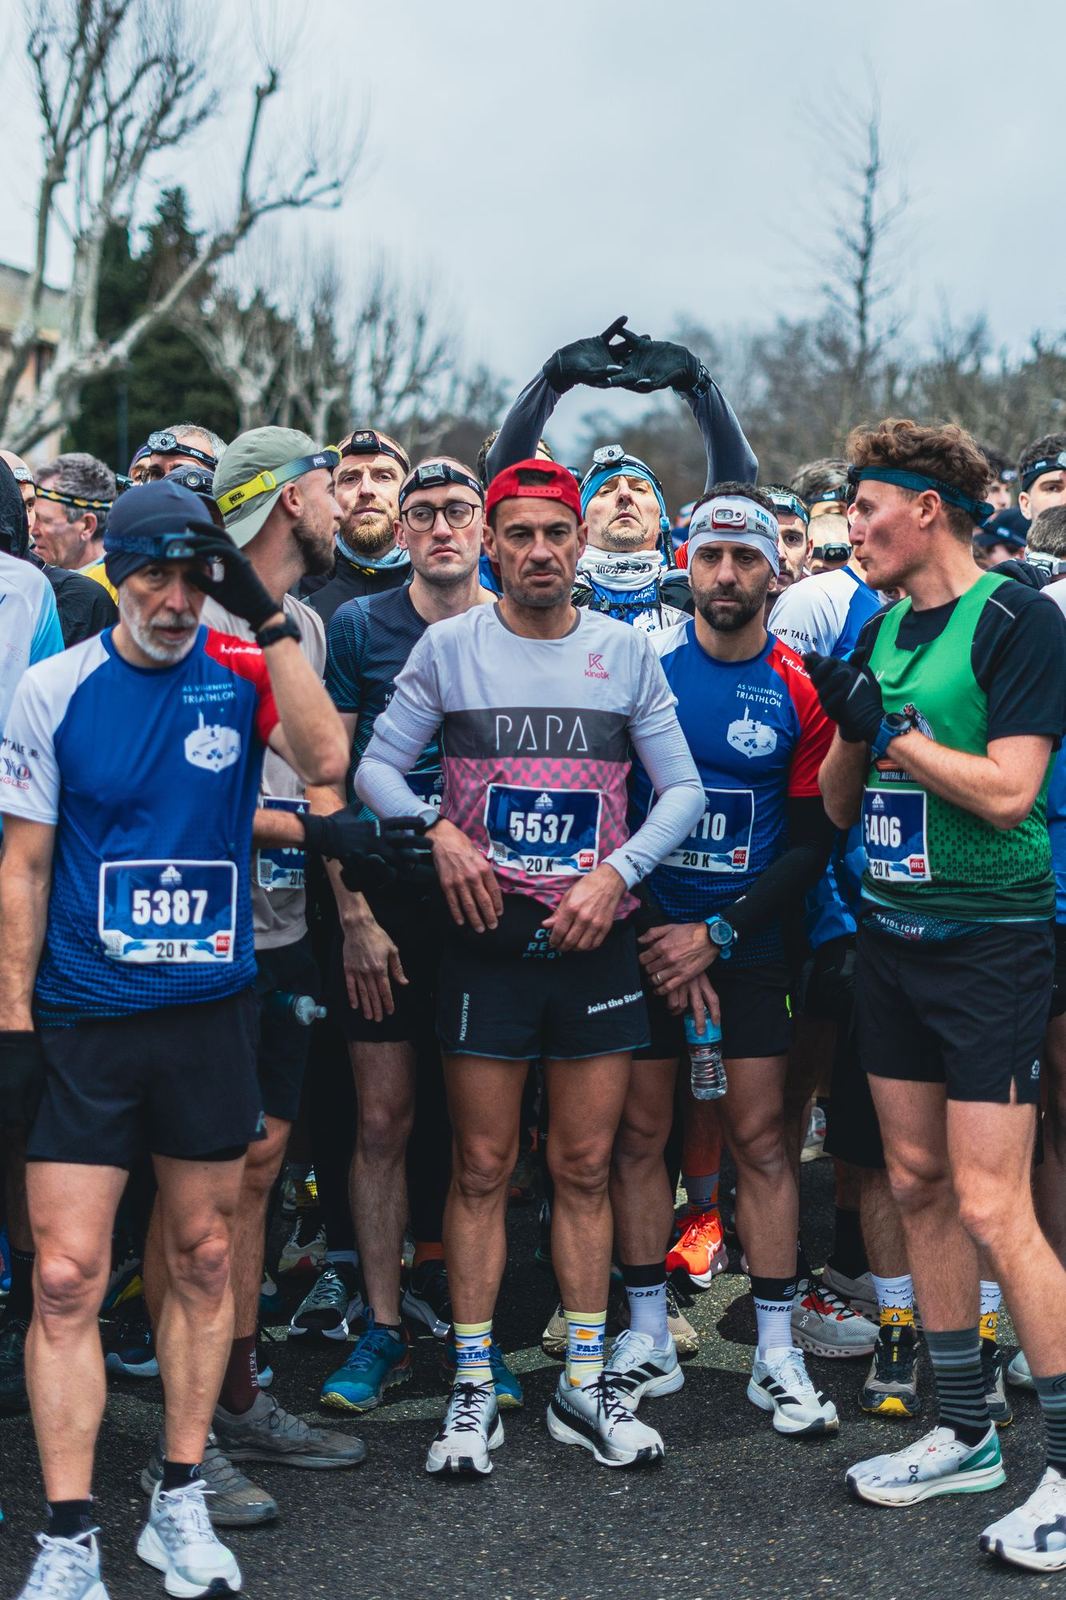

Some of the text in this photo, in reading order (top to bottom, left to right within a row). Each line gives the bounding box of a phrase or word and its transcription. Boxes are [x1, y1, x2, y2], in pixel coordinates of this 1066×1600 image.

[495, 714, 588, 751] PAPA
[509, 811, 575, 844] 5537
[526, 858, 554, 872] 20 K
[682, 851, 711, 868] 20 K
[873, 861, 890, 877] 20 K
[132, 889, 208, 926] 5387
[156, 941, 188, 958] 20 K
[587, 1003, 607, 1014] Join
[607, 999, 624, 1009] the
[459, 992, 470, 1041] SALOMON
[628, 1288, 661, 1298] PORT
